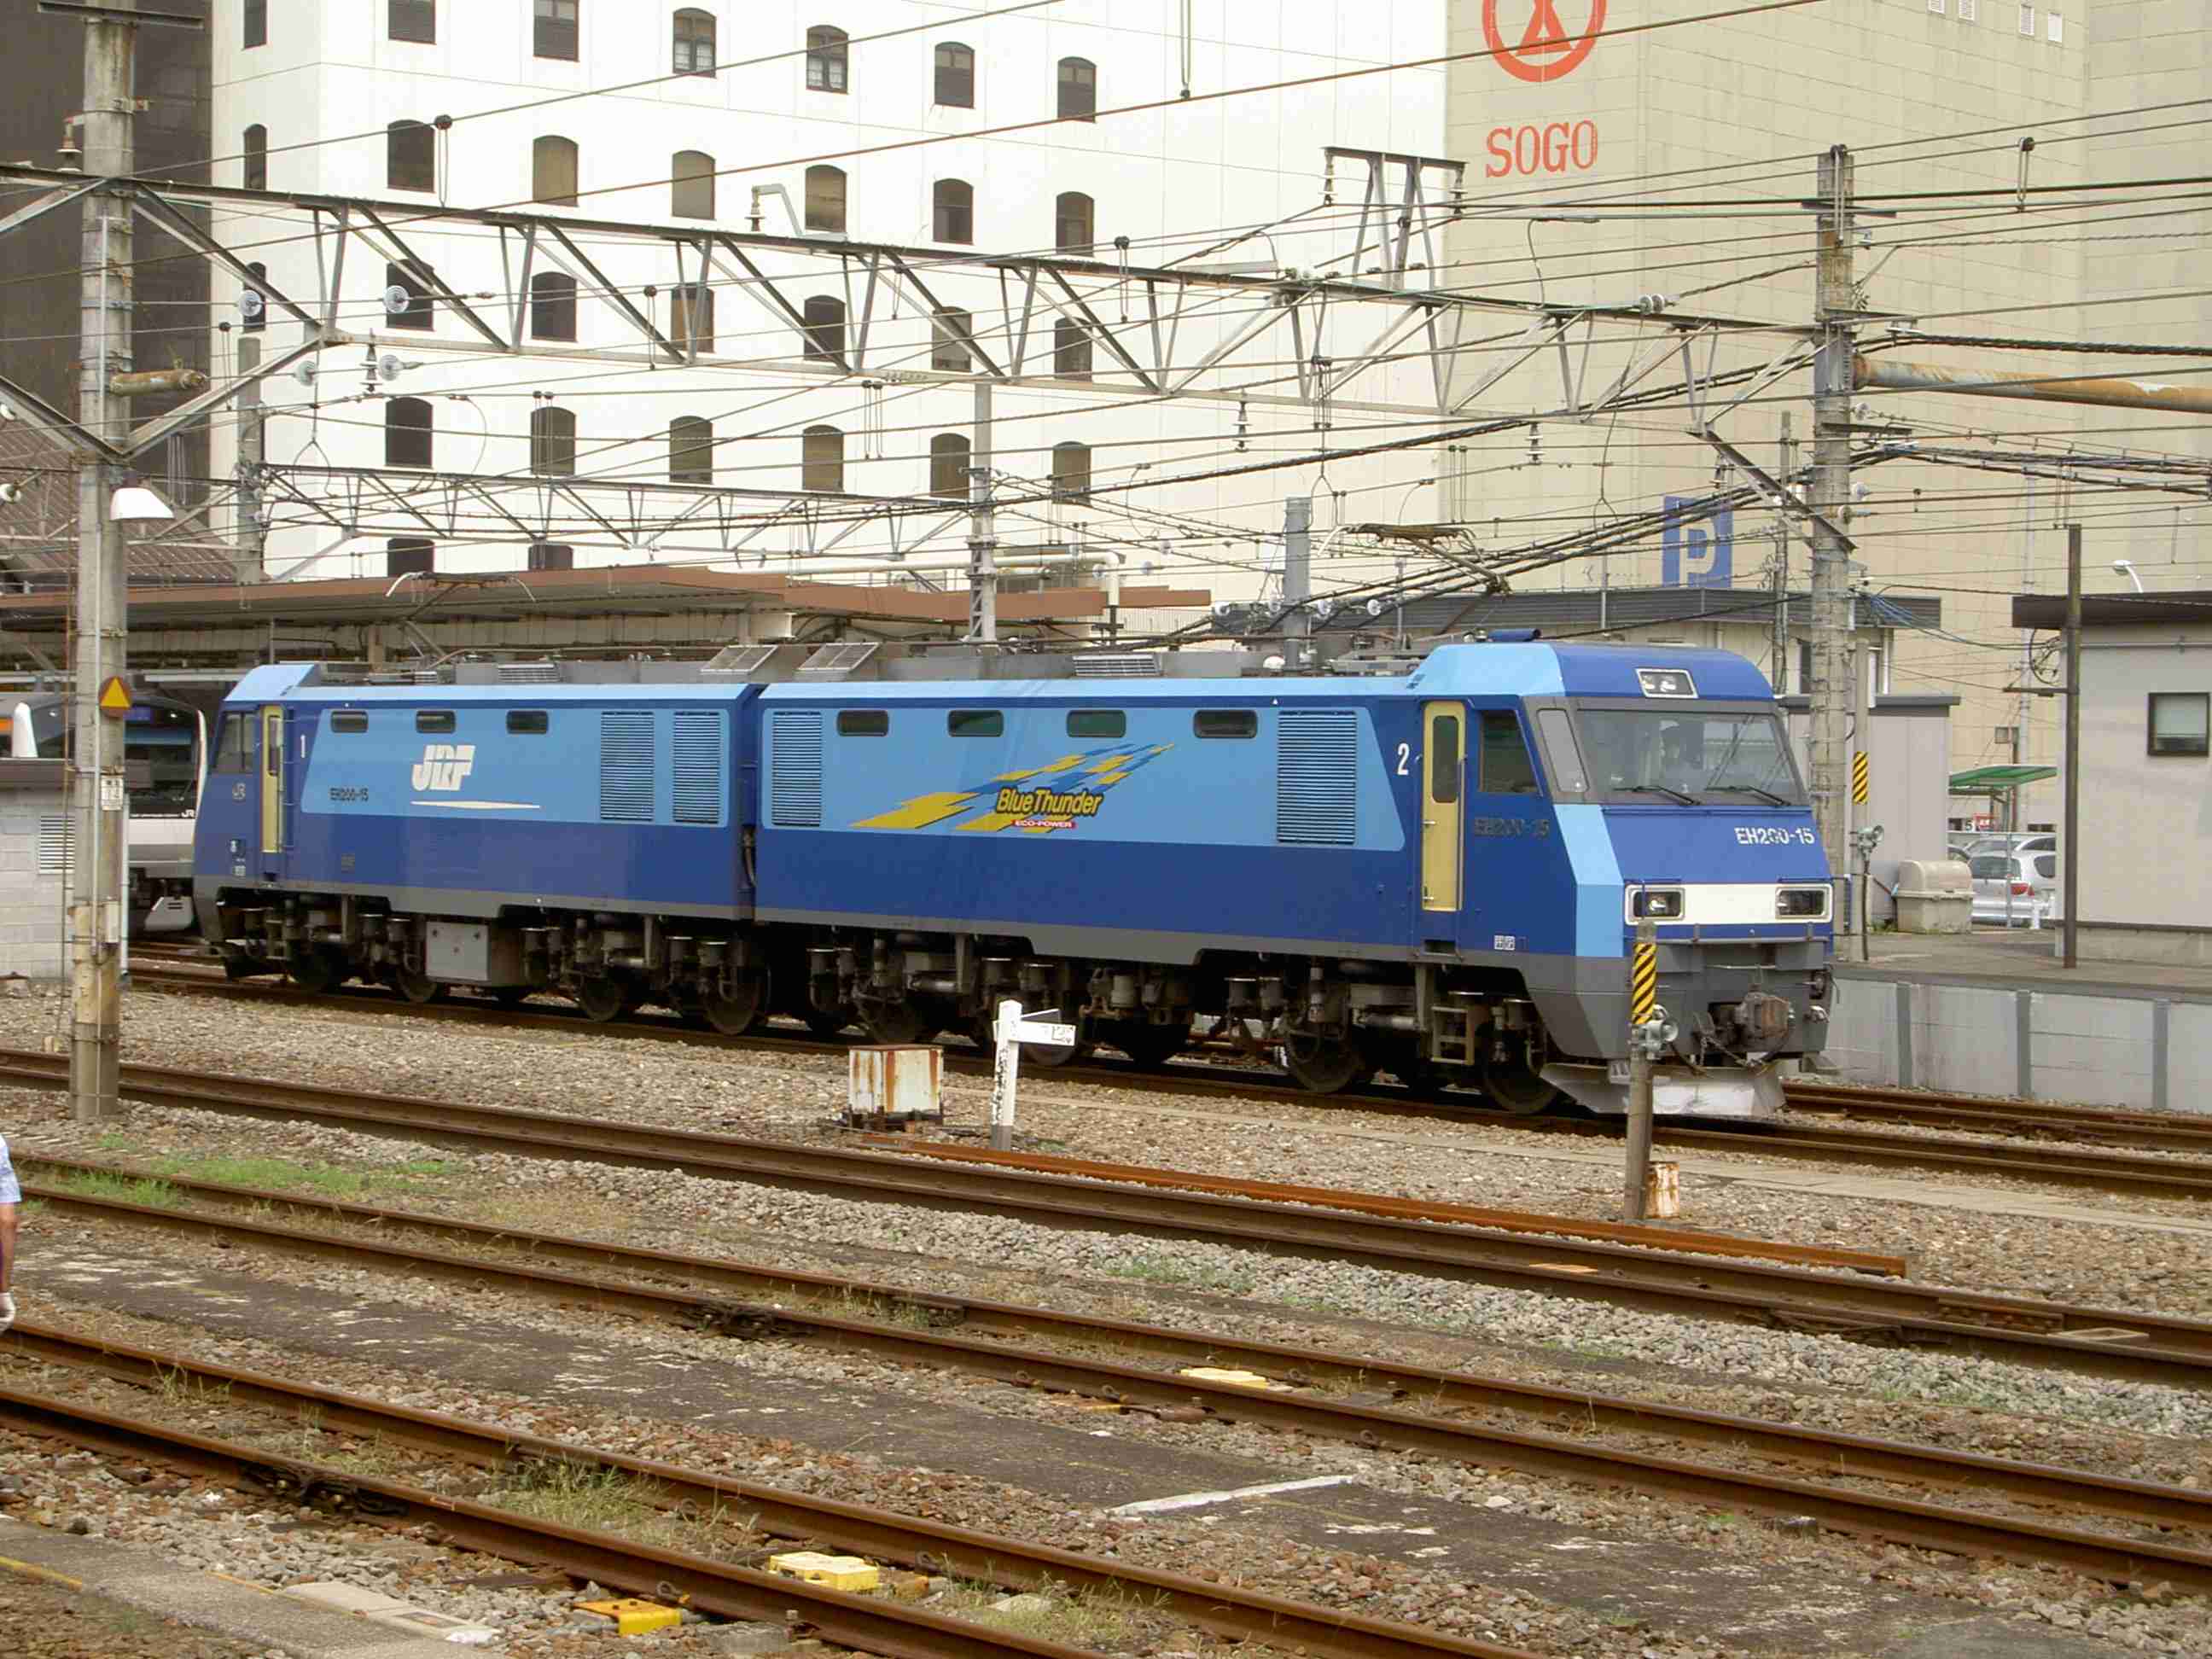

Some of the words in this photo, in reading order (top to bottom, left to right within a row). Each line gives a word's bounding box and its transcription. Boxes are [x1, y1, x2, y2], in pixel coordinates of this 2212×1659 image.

[1486, 119, 1598, 178] SOGO
[1679, 517, 1715, 587] P
[1397, 742, 1410, 776] 2
[1734, 826, 1816, 845] EH200-15
